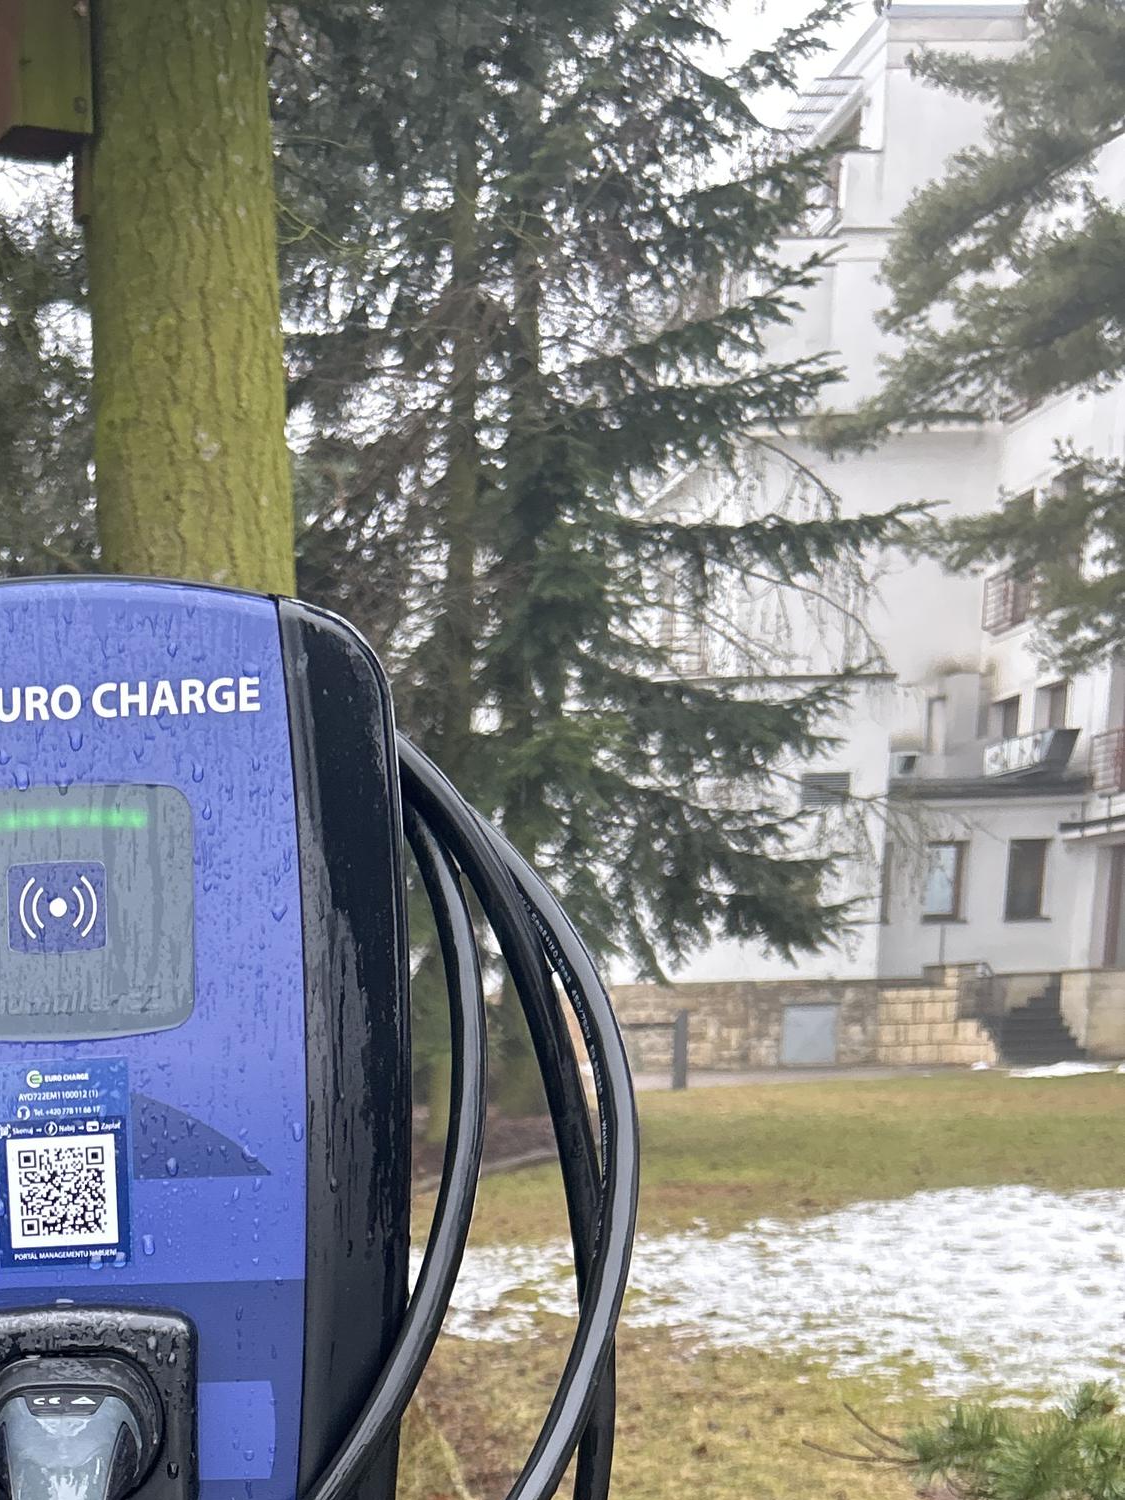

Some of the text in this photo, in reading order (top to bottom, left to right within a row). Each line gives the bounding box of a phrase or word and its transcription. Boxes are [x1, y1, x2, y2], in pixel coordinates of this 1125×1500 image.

[91, 676, 262, 718] CHARGE
[44, 1072, 90, 1083] EURO CHARGE
[45, 1108, 62, 1116] +420
[38, 1250, 89, 1260] MANAGEMENTU
